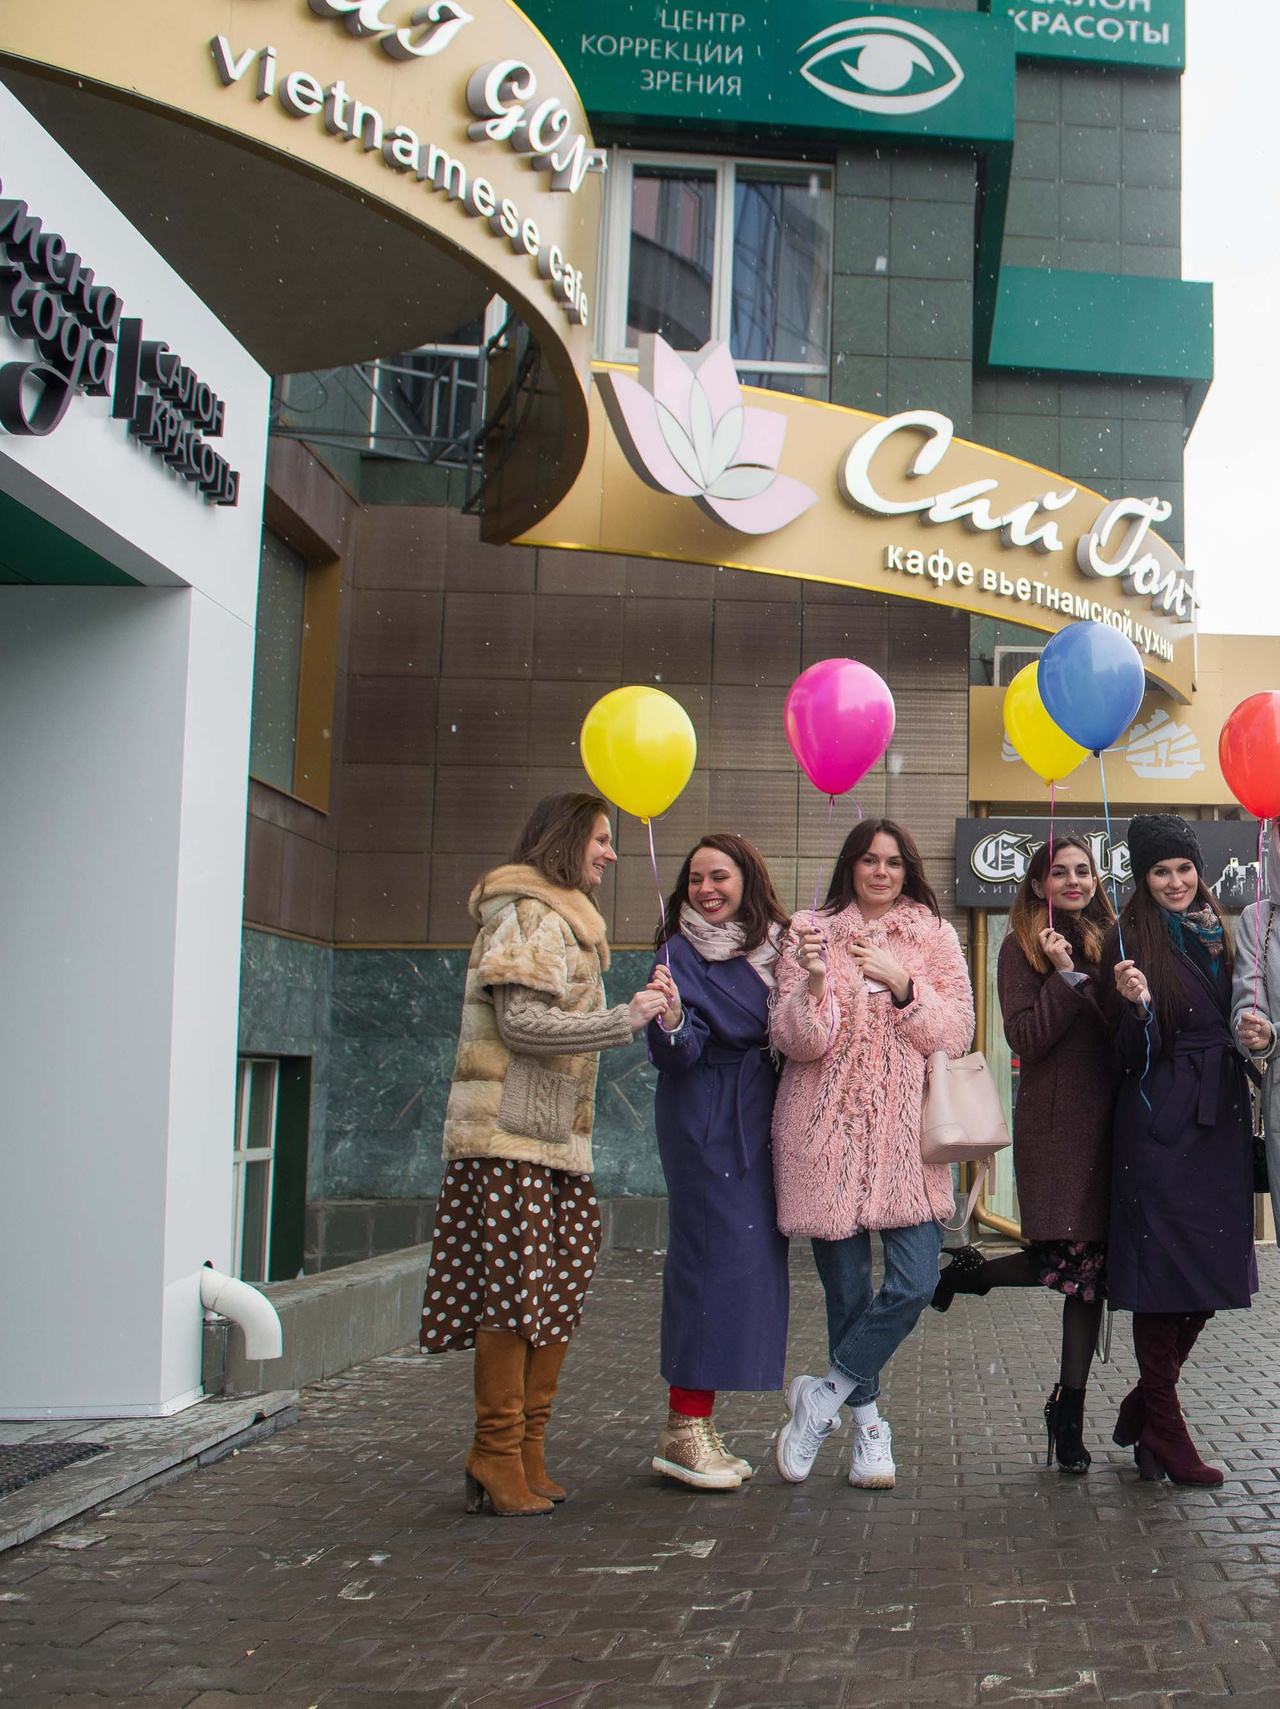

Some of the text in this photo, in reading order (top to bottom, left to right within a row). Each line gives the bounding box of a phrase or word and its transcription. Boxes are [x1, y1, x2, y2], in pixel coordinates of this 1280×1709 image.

[660, 8, 746, 33] ЦЕНТР
[1012, 9, 1171, 46] КРАСОТЫ
[580, 33, 743, 66] КОРРЕКЦИИ
[639, 68, 742, 97] ЗРЕНИЯ
[211, 34, 589, 327] vietnamese cafe
[840, 409, 1077, 552] Сай
[885, 545, 1175, 663] кафе вьетнамской кухни
